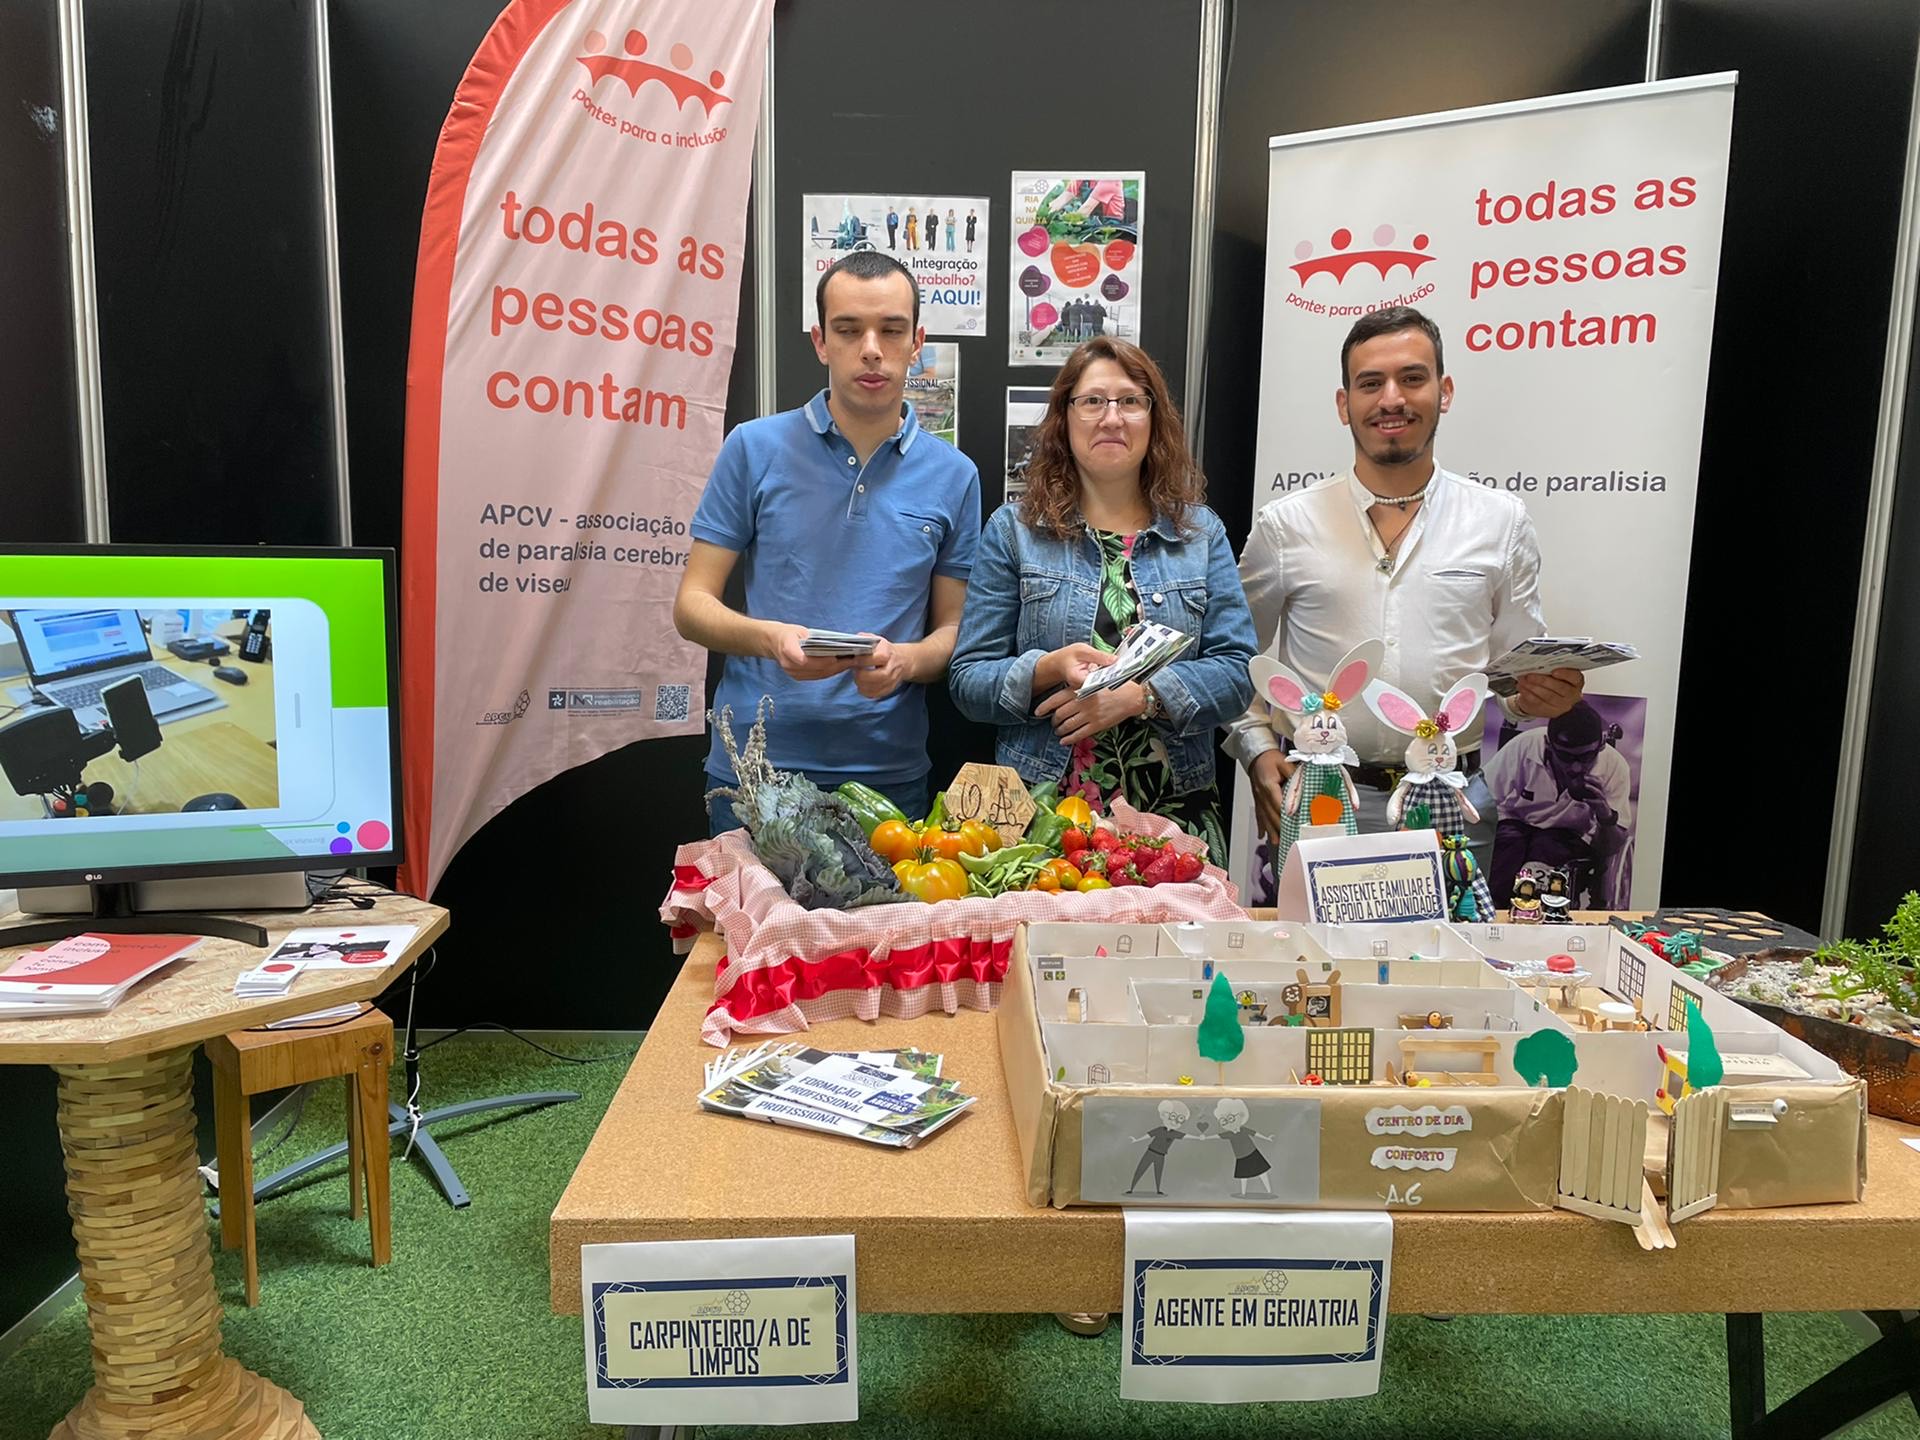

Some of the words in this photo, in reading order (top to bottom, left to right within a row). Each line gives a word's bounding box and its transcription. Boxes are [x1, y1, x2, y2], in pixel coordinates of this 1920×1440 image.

[572, 88, 617, 127] pontes
[620, 120, 657, 143] para
[661, 133, 672, 145] a
[676, 127, 727, 148] inclusão
[1475, 181, 1617, 226] todas
[1633, 175, 1697, 210] as
[500, 190, 659, 266] todas
[677, 236, 725, 280] as
[912, 257, 978, 272] Integração
[1470, 243, 1688, 299] pessoas
[917, 273, 976, 286] trabalho?
[931, 289, 981, 305] AQUI!
[1285, 292, 1327, 314] pontes
[1329, 304, 1362, 317] para
[1366, 304, 1376, 314] a
[1380, 282, 1435, 311] inclusão
[490, 285, 714, 357] pessoas
[1465, 309, 1657, 352] contam
[486, 371, 687, 430] contam
[1505, 471, 1538, 492] de
[1546, 470, 1667, 497] paralisia
[479, 503, 552, 528] APCV
[575, 512, 686, 538] associação
[479, 538, 510, 559] de
[517, 541, 606, 564] paralisia
[479, 572, 509, 593] de
[516, 573, 572, 593] viseu
[1321, 881, 1378, 905] ASSISTENTE
[1379, 877, 1425, 899] FAMILIAR
[1426, 876, 1433, 895] E
[1320, 904, 1333, 923] DE
[1334, 902, 1365, 924] APOIO
[1375, 895, 1439, 918] COMUNIDADE
[784, 1084, 864, 1114] PROFISSIONAL
[799, 1076, 862, 1098] FORMAÇÃO
[756, 1100, 842, 1125] PROFISSIONAL
[1377, 1116, 1423, 1127] CENTRO
[1425, 1116, 1441, 1125] DE
[1444, 1115, 1465, 1125] DIA
[1385, 1149, 1445, 1161] CONFORTO
[1154, 1298, 1225, 1327] AGENTE
[1231, 1298, 1257, 1327] EM
[1264, 1298, 1359, 1327] GERIATRIA
[630, 1318, 780, 1350] CARPINTEIRO/A
[787, 1317, 811, 1346] DE
[689, 1347, 759, 1376] LIMPOS
